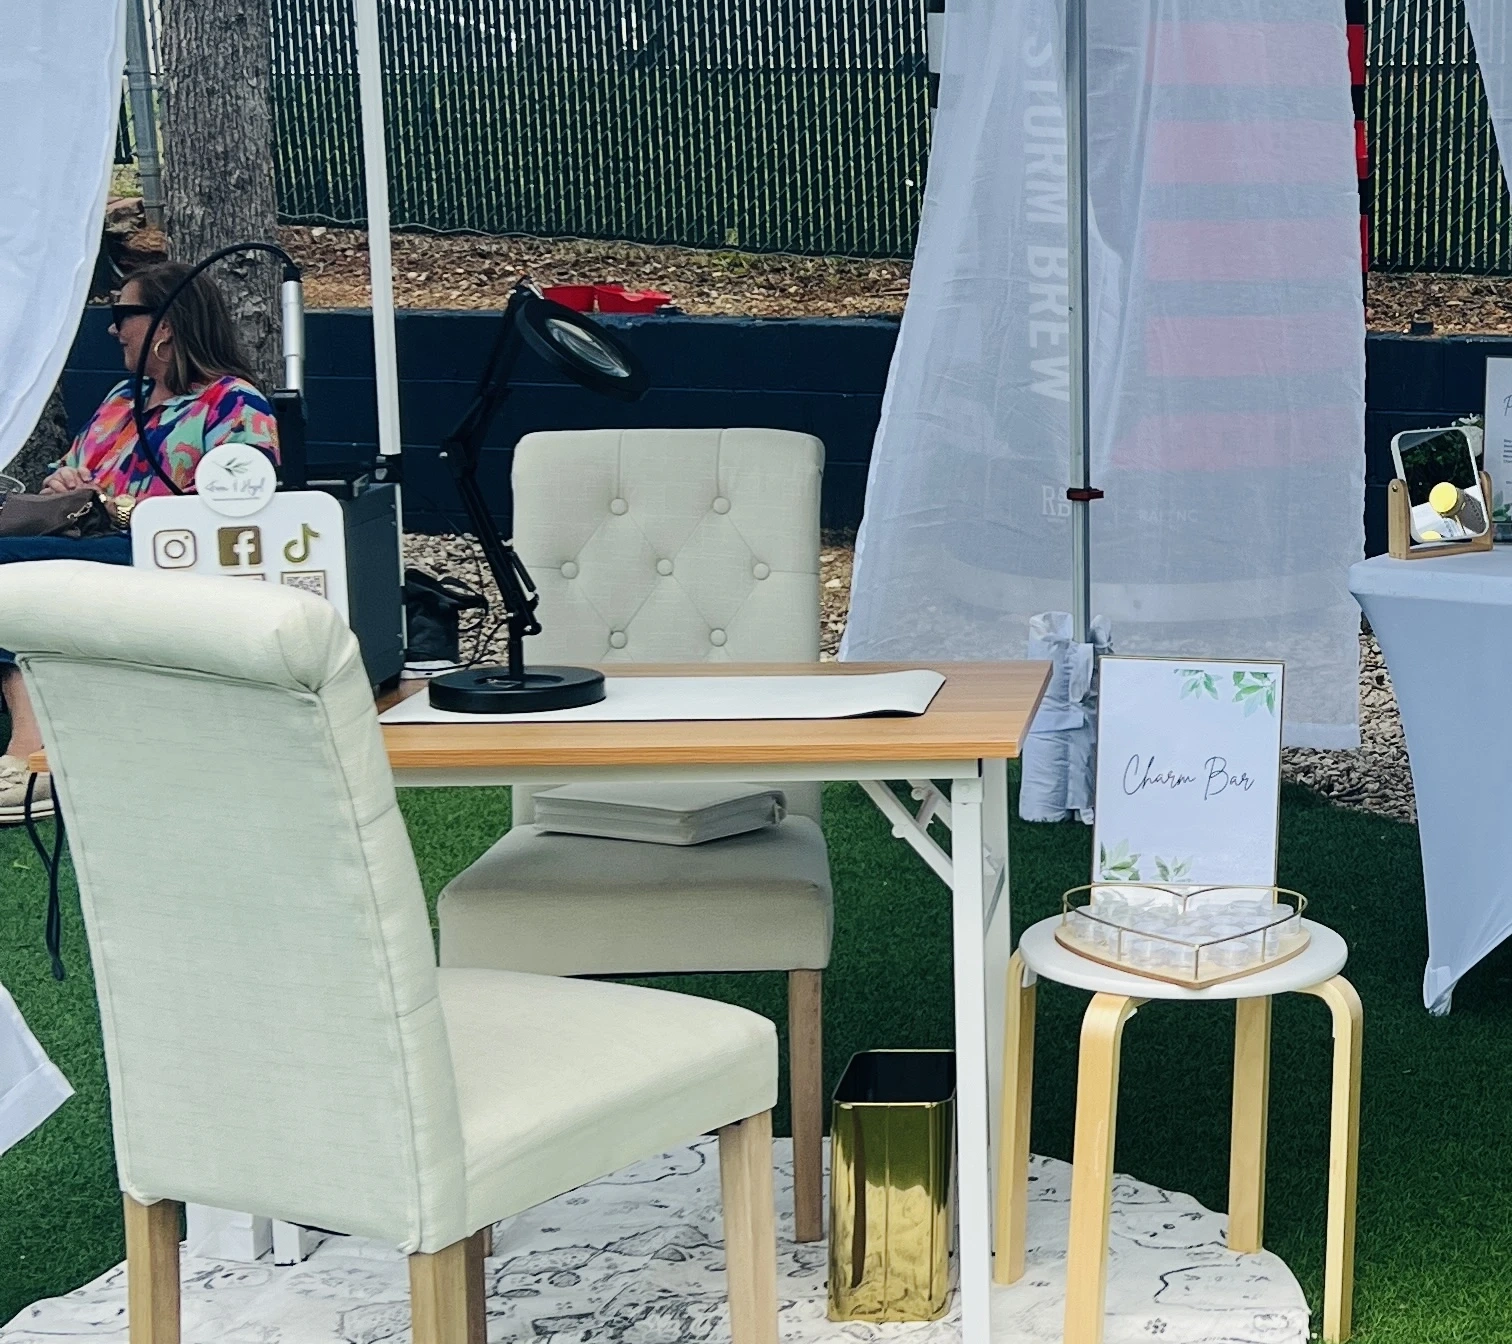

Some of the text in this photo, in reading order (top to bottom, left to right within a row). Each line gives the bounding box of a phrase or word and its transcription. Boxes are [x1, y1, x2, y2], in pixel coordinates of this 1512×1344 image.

[1025, 244, 1071, 403] BREW
[1122, 754, 1256, 801] Charm Bar
